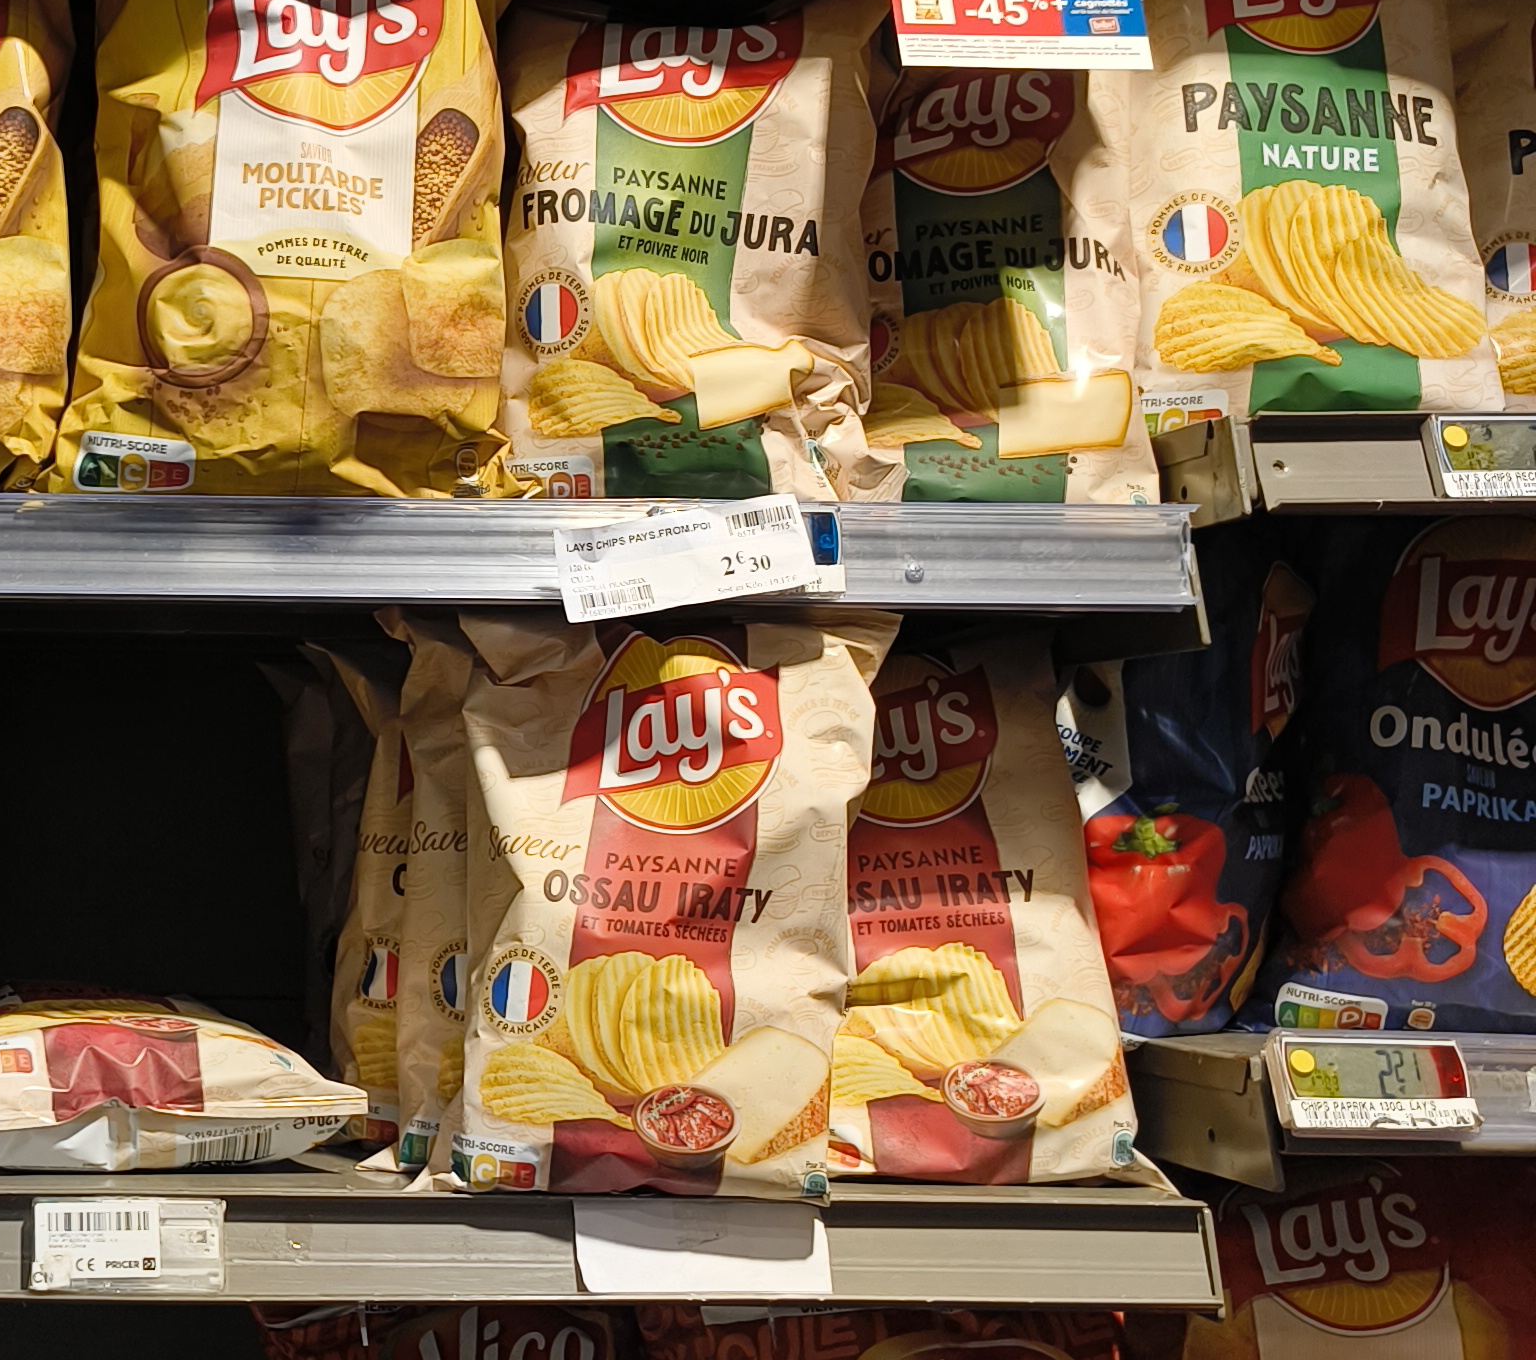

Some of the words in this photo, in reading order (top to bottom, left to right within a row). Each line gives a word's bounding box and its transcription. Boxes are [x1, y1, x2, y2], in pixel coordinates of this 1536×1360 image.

[1181, 82, 1439, 147] PAYSANNE
[1261, 142, 1380, 174] NATURE
[241, 160, 386, 201] MOUTARDE
[613, 167, 728, 202] PAYSANNE
[522, 188, 682, 238] FROMAGE
[690, 212, 716, 239] DU
[719, 210, 820, 257] JURA
[256, 235, 311, 258] POMMES
[313, 236, 329, 248] DE
[331, 238, 370, 264] TERRE
[276, 254, 292, 267] DE
[295, 252, 348, 270] QUALITÉ
[618, 237, 634, 251] ET
[637, 238, 677, 261] POIVRE
[679, 246, 710, 267] NOIR
[86, 433, 169, 456] NUTRI-SCORE
[566, 541, 594, 553] LAYS
[596, 535, 627, 550] CHIPS
[600, 667, 765, 789] Lay's
[486, 825, 582, 862] Saveur
[605, 852, 738, 878] PAYSANNE
[544, 870, 663, 914] OSSAU
[676, 882, 773, 926] IRATY
[581, 917, 597, 931] ET
[600, 918, 670, 939] TOMATES
[673, 920, 728, 945] SÉCHÉES
[1301, 1101, 1330, 1111] CHIPS
[1333, 1101, 1376, 1112] PAPRIKA
[1242, 1176, 1427, 1287] Lay's
